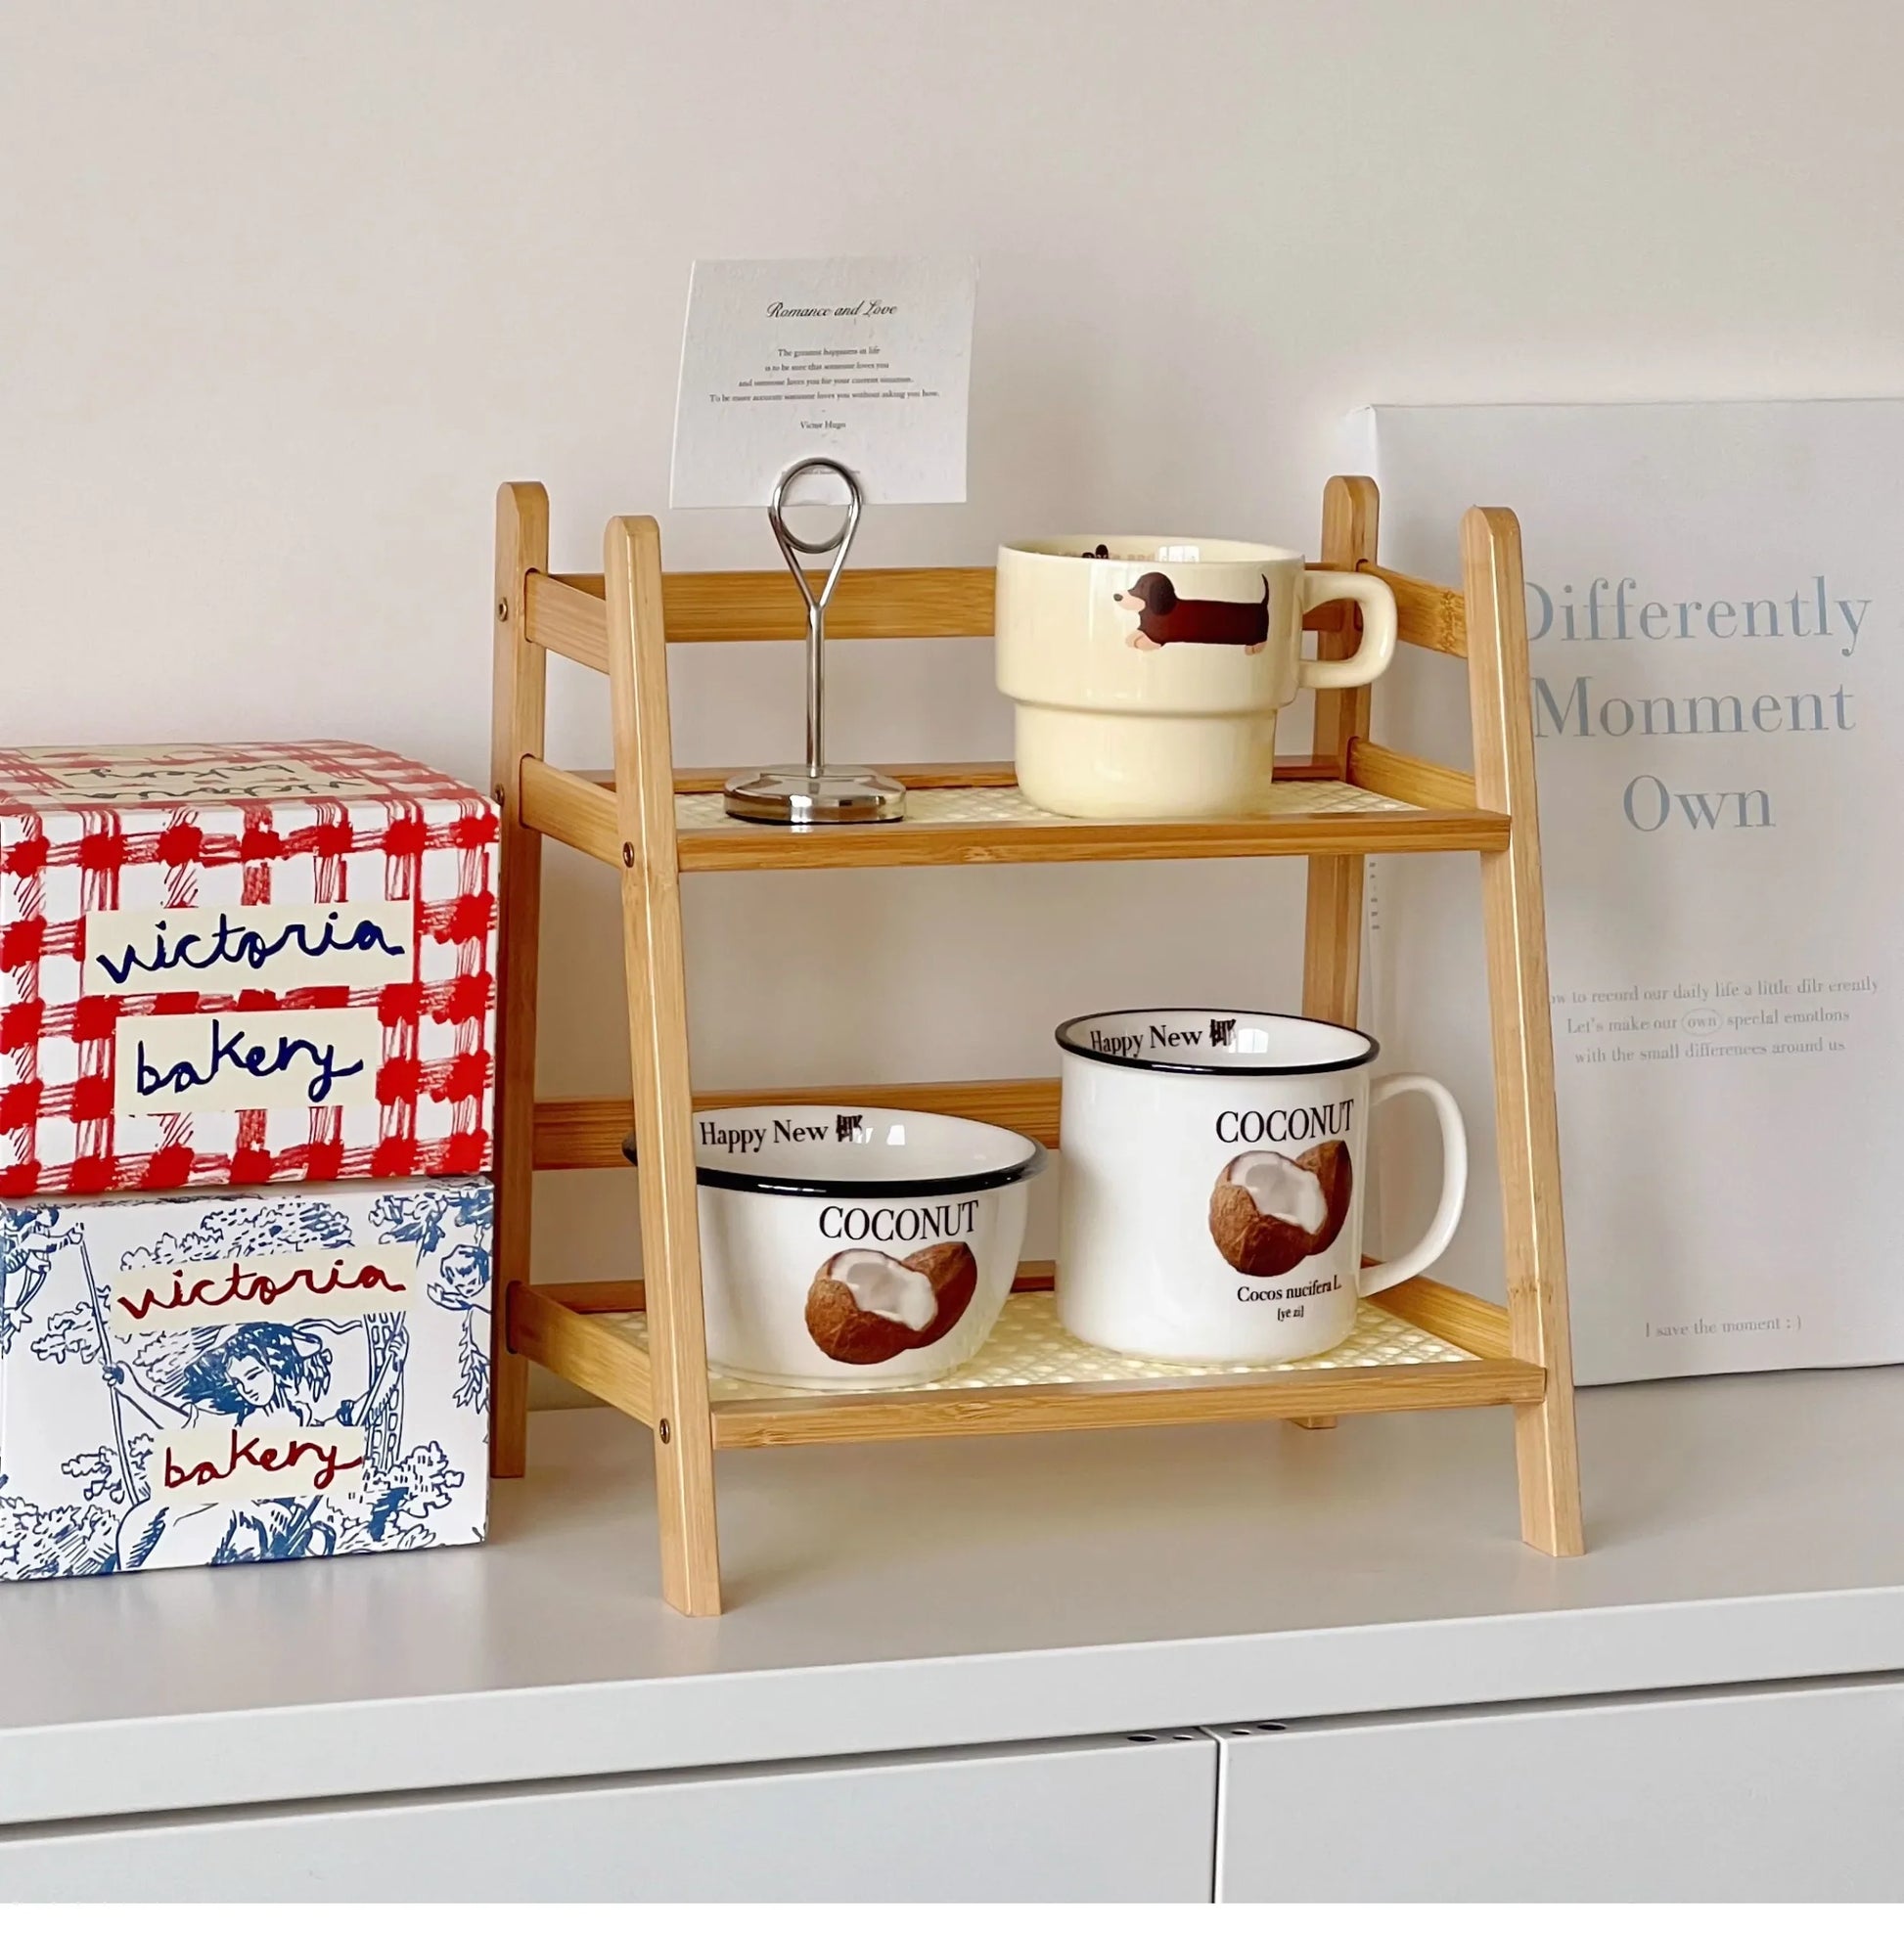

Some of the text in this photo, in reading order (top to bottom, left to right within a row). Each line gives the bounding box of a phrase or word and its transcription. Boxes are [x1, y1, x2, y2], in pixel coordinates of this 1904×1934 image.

[767, 299, 897, 317] Romance and Love
[778, 348, 792, 357] The
[825, 421, 846, 429] Hugo
[1524, 574, 1872, 656] Differently
[1530, 675, 1855, 738] Monment
[1622, 775, 1776, 832] Own
[96, 911, 405, 984] victoria
[1572, 992, 1587, 1004] to
[1592, 985, 1640, 1003] record
[1644, 990, 1669, 1001] our
[1673, 982, 1709, 1002] daily
[1715, 980, 1739, 998] life
[1745, 986, 1752, 996] a
[1758, 979, 1790, 996] little
[1090, 1030, 1144, 1058] Happy
[1149, 1025, 1202, 1049] New
[1567, 1017, 1602, 1034] Let's
[1609, 1015, 1650, 1032] make
[1654, 1018, 1678, 1029] our
[1688, 1016, 1716, 1028] own
[137, 1019, 364, 1102] bakery
[1574, 1036, 1845, 1063] with the small differences around us
[699, 1122, 767, 1153] Happy
[772, 1119, 829, 1144] New
[1216, 1099, 1354, 1143] COCONUT
[819, 1199, 978, 1241] COCONUT
[117, 1258, 406, 1320] victoria
[1237, 1285, 1283, 1302] Cocos
[1645, 1322, 1651, 1337] I
[1656, 1326, 1689, 1337] save
[1694, 1318, 1717, 1335] the
[1722, 1318, 1780, 1333] moment
[163, 1429, 364, 1490] bakery
